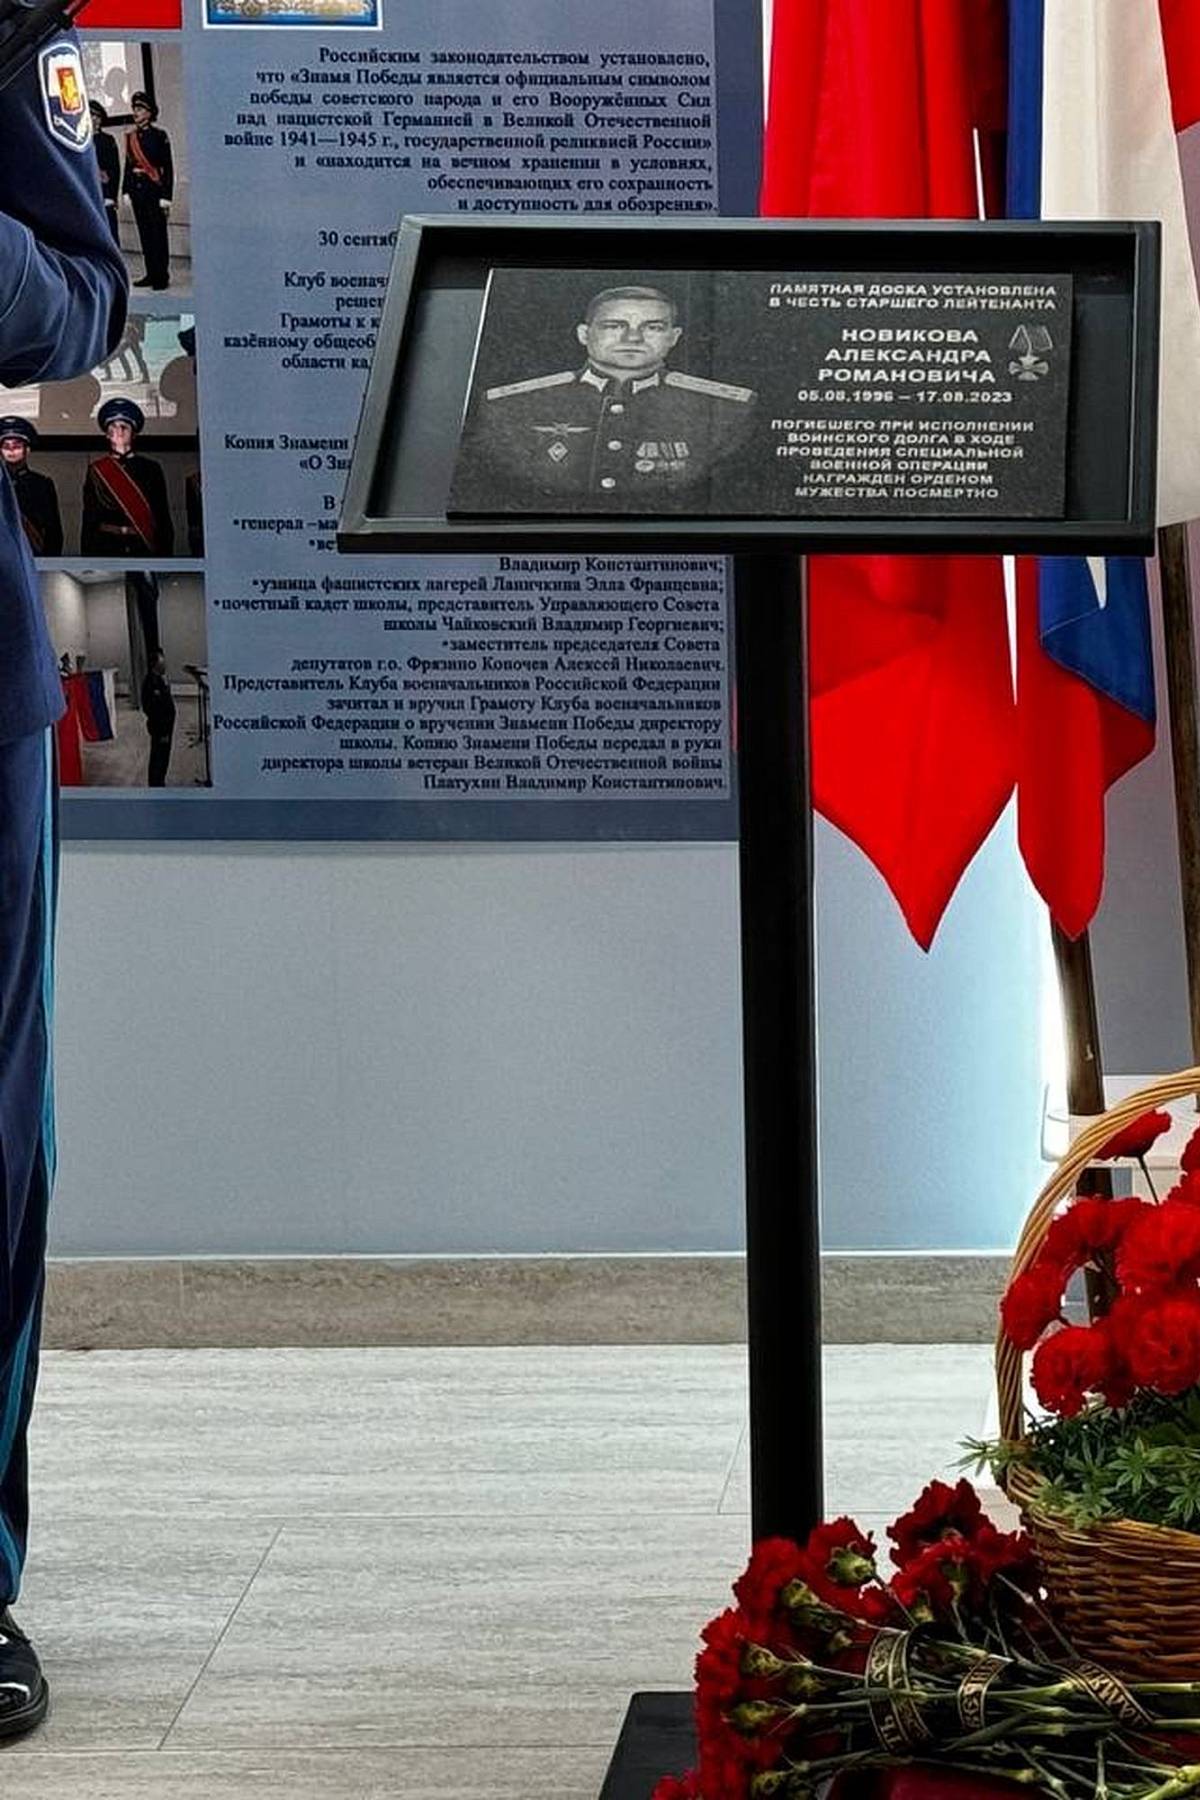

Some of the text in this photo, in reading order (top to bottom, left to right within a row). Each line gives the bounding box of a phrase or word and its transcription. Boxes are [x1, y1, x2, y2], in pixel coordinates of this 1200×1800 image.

[770, 284, 1057, 297] ПАМЯТНАЯ ДОСКА УСТАНОВЛЕНА
[769, 297, 1056, 310] В ЧЕСТЬ СТАРШЕГО ЛЕЙТЕНАНТА
[842, 330, 979, 343] НОВИКОВА
[824, 349, 991, 364] АЛЕКСАНДРА
[818, 369, 996, 384] РОМАНОВИЧА
[916, 391, 1013, 403] 17.08.2023
[771, 419, 1034, 433] ПОГИБШЕГО ПРИ ИСПОЛНЕНИИ
[787, 433, 1015, 446] ВОИНСКОГО ДОЛГА В ХОДЕ
[776, 445, 1024, 459] ПРОВЕДЕНИЯ СПЕЦИАЛЬНОЙ
[810, 458, 988, 472] ВОЕННОЙ ОПЕРАЦИИ
[803, 474, 993, 486] НАГРАЖДЕН ОРДЕНОМ
[794, 487, 999, 499] МУЖЕСТВА ПОСМЕРТНО
